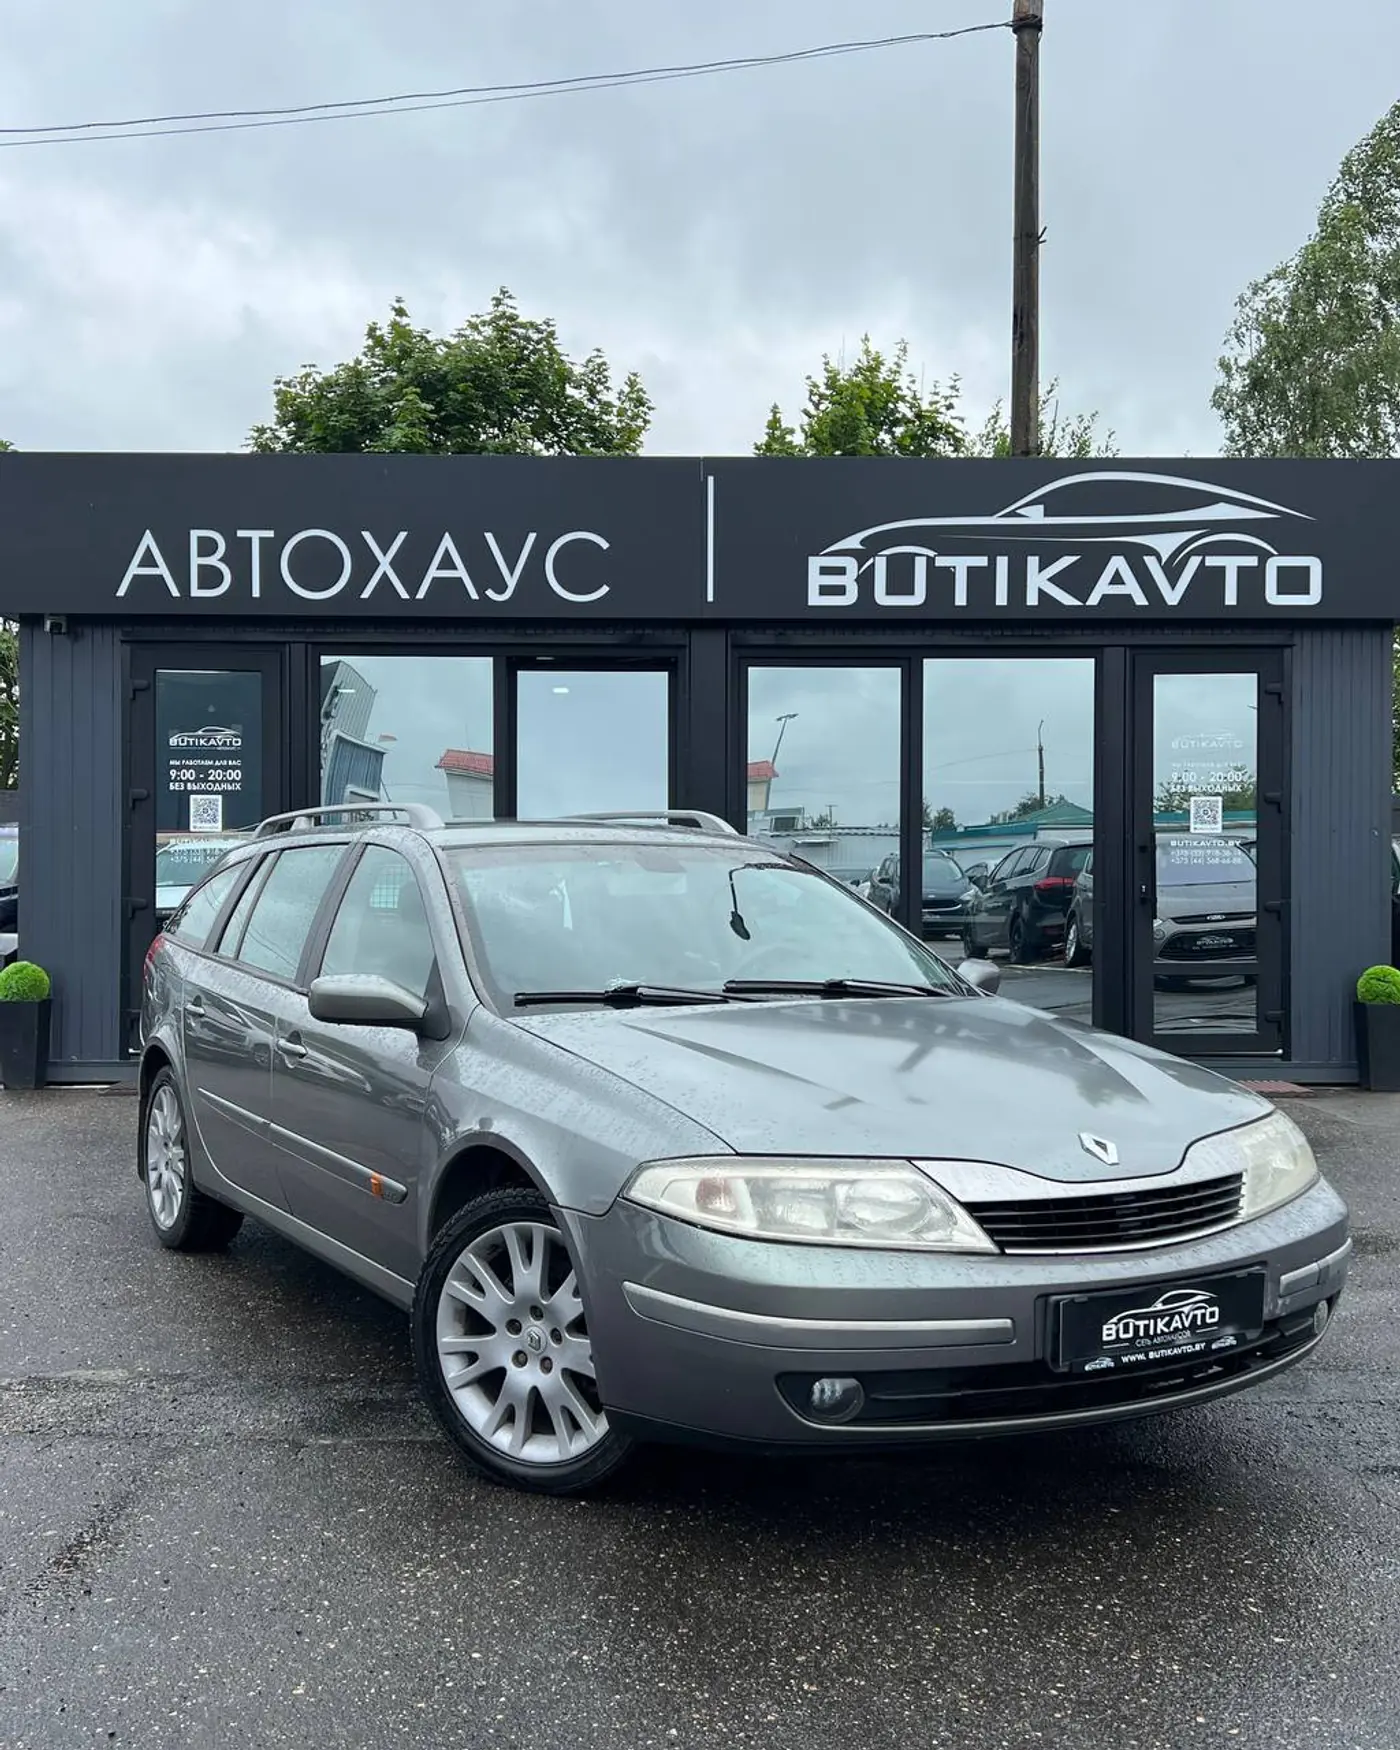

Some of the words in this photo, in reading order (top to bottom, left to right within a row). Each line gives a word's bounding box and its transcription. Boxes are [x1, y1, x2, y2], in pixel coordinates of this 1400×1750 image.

[115, 528, 610, 602] АВТОХАУС
[808, 555, 1322, 606] BUTIKAVTO
[169, 737, 241, 746] BUTIKAVTO
[169, 769, 196, 780] 9:00
[208, 769, 242, 780] 20:00
[1171, 772, 1196, 782] 9:00
[1210, 771, 1242, 782] 20:00
[169, 782, 184, 791] БЕЗ
[187, 782, 242, 791] ВЫХОДНЫХ
[1102, 1306, 1220, 1341] BUTIKAVTO
[1148, 1342, 1206, 1359] BUTIKAVTO.BY
